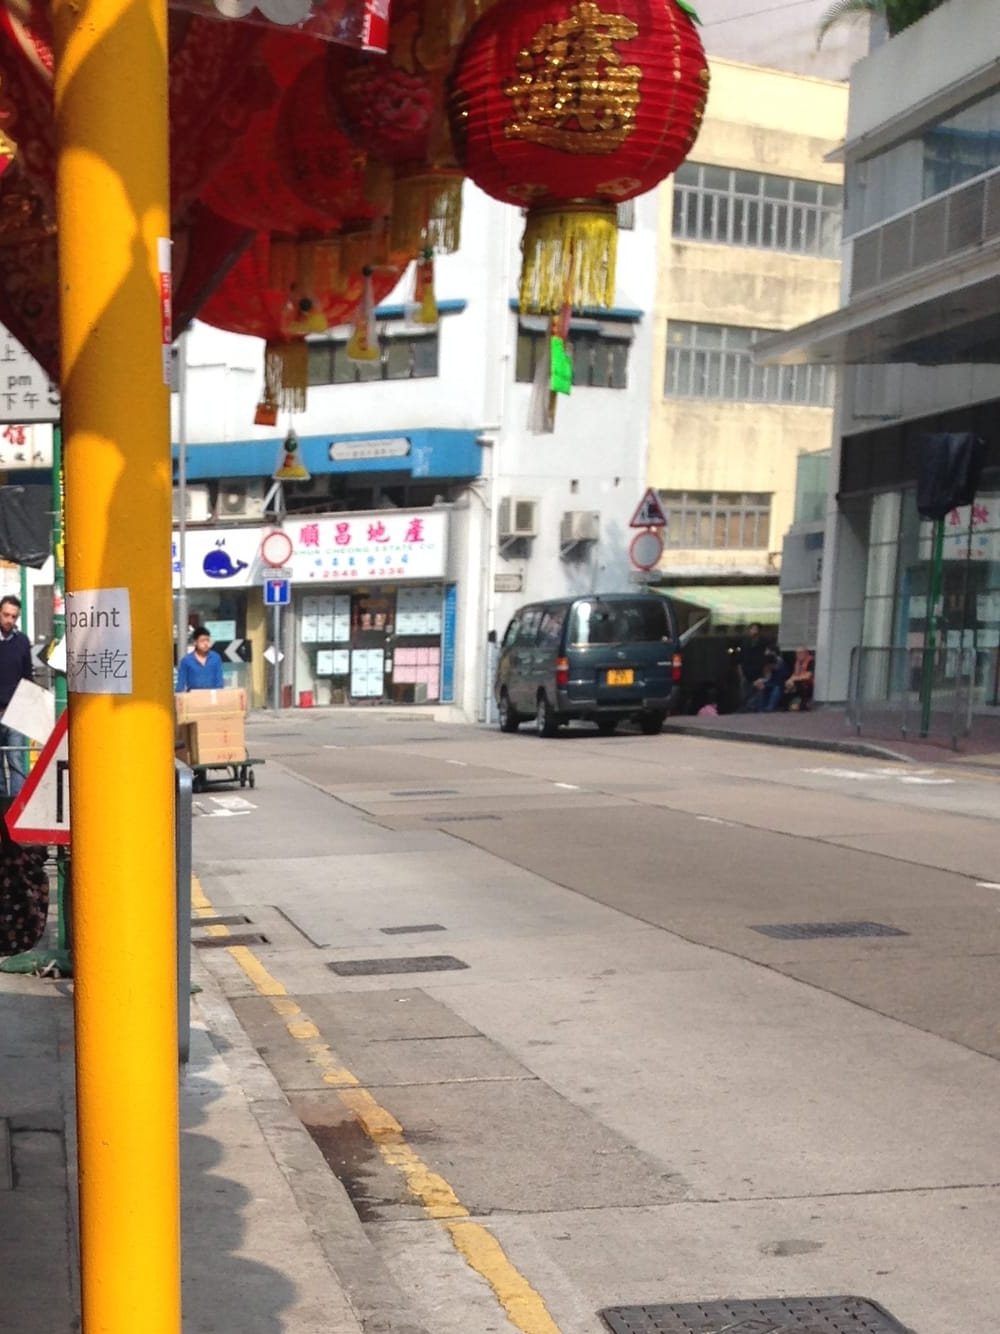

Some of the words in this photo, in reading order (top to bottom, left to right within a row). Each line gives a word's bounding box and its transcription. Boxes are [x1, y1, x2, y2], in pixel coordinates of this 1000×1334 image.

[7, 375, 32, 389] pm
[0, 392, 39, 410] 下午
[299, 518, 425, 547] 順昌地產
[69, 606, 120, 632] paint
